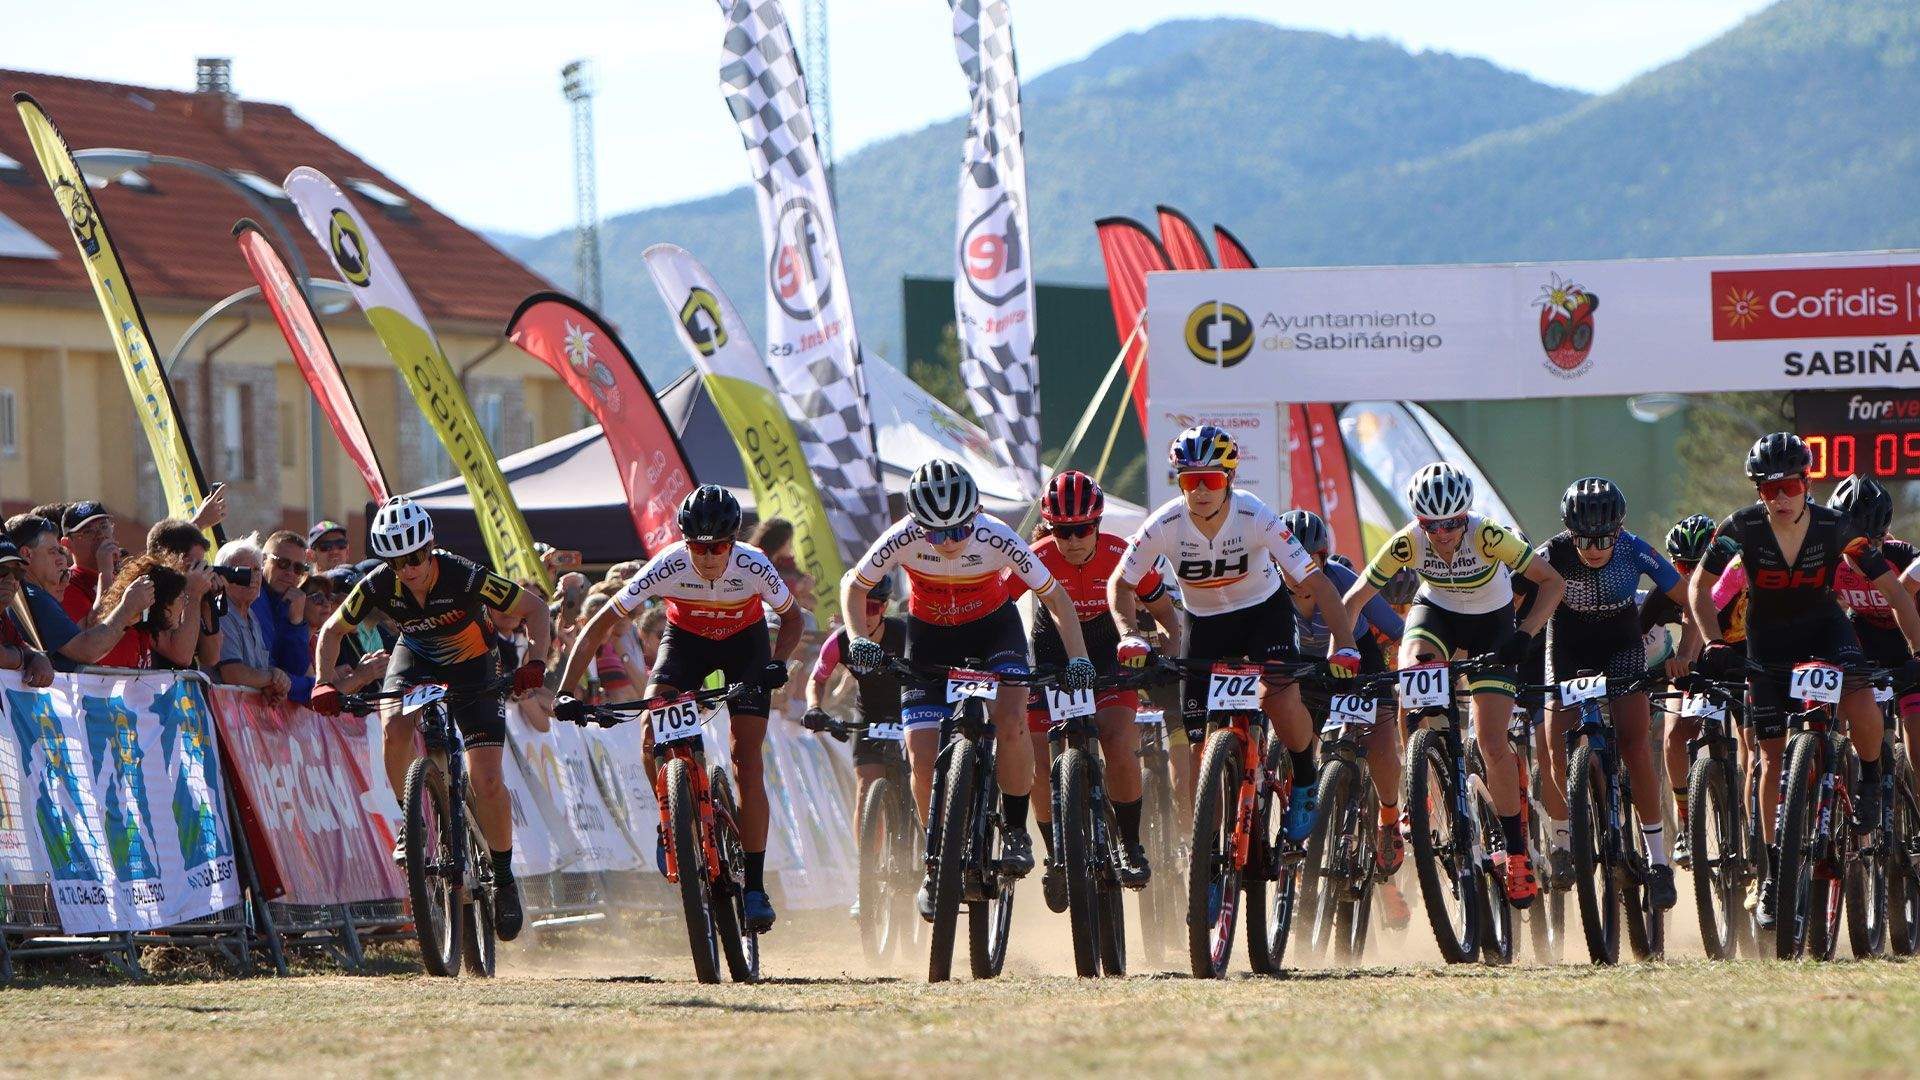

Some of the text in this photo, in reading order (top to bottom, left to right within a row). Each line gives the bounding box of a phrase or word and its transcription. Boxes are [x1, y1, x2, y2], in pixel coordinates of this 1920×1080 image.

[1769, 286, 1899, 319] Cofidis
[1260, 309, 1437, 332] Ayuntamiento
[1784, 340, 1920, 377] SABIÑÁ
[871, 525, 926, 569] Cofidis
[975, 526, 1034, 575] Cofidis
[628, 557, 688, 597] Cofidis
[735, 553, 783, 596] Cofidis
[1177, 554, 1249, 581] BH
[1755, 568, 1828, 589] BH
[1213, 675, 1257, 697] 702
[1402, 668, 1442, 696] 701
[1796, 668, 1839, 690] 703
[652, 702, 697, 733] 705
